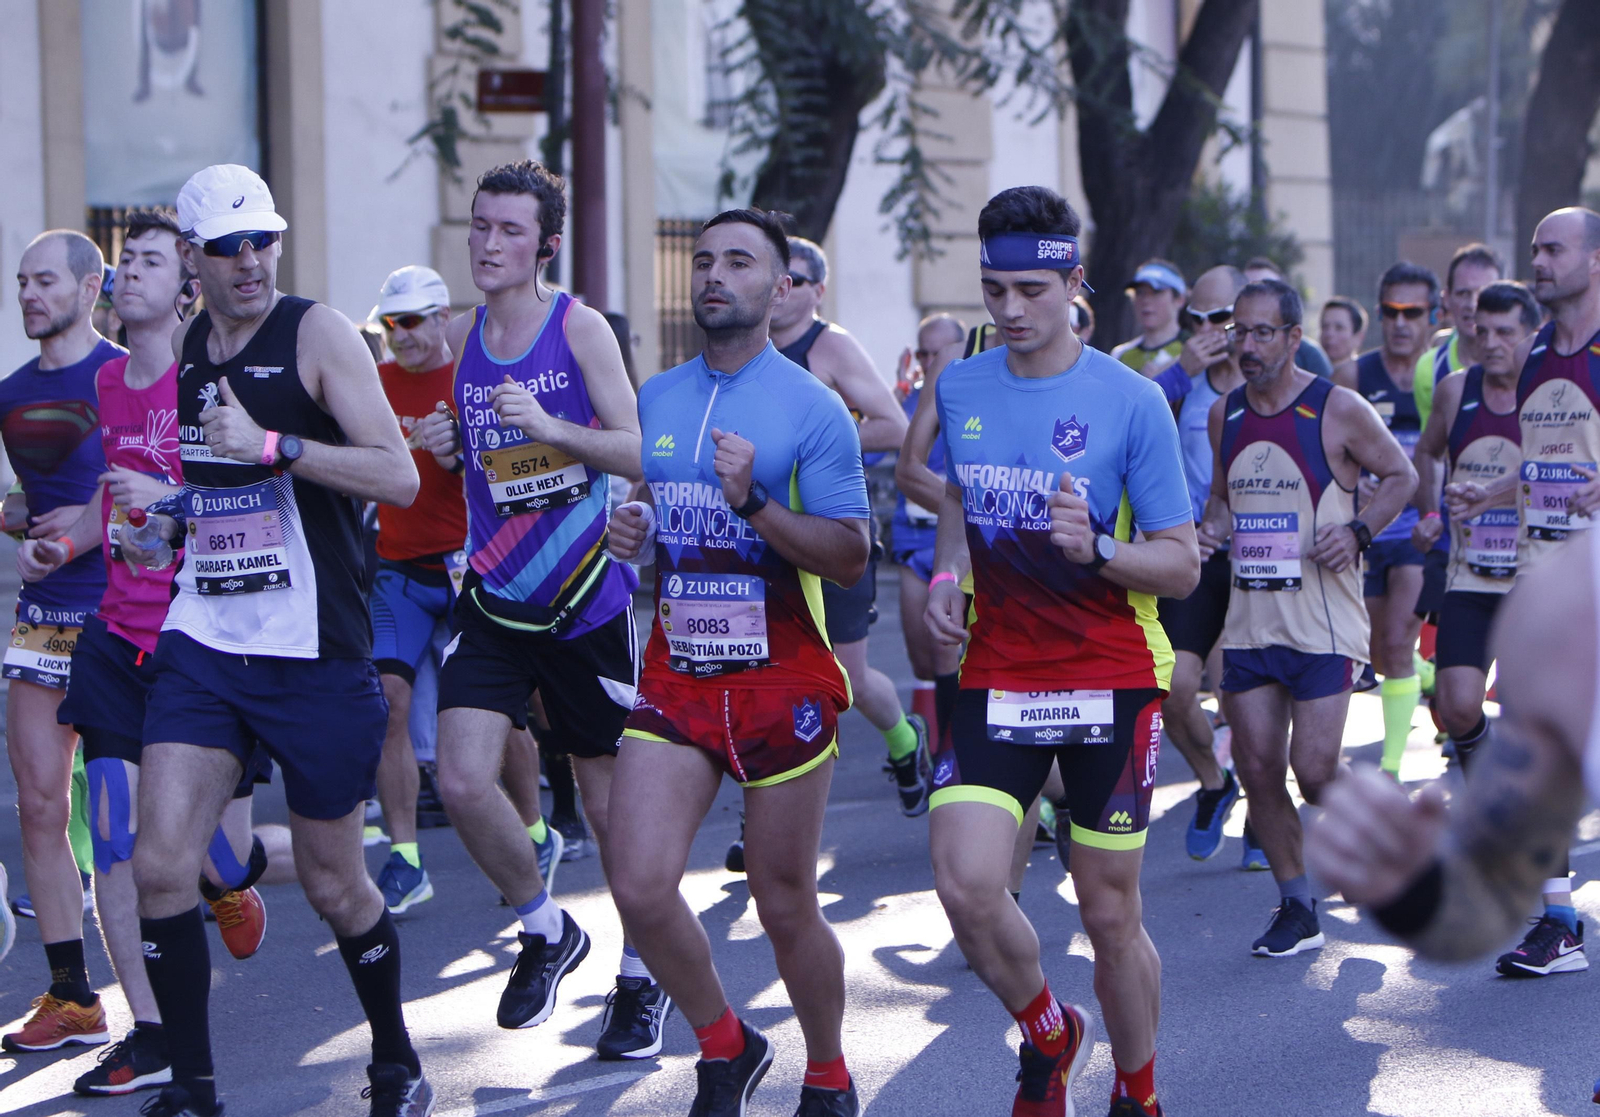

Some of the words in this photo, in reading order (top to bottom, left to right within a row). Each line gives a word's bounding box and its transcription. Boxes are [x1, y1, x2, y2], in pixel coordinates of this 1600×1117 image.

[1037, 249, 1067, 260] SPORT
[463, 370, 569, 405] Panatic
[464, 405, 501, 428] Can
[120, 435, 144, 445] trust
[1539, 443, 1573, 456] JORGE
[511, 455, 550, 476] 5574
[506, 482, 535, 497] OLLIE
[536, 474, 564, 490] HEXT
[955, 464, 1091, 500] INFORMALS
[205, 493, 261, 512] ZURICH
[567, 493, 587, 504] ZURICH
[997, 518, 1014, 528] DEL
[1239, 518, 1288, 529] ZURICH
[1483, 513, 1518, 525] ZURIC
[209, 532, 246, 551] 6817
[681, 536, 699, 546] DEL
[705, 539, 737, 549] ALCOR
[1241, 546, 1272, 558] 6697
[195, 560, 235, 573] CHARAFA
[237, 554, 282, 571] KAMEL
[1240, 565, 1277, 574] ANTONIO
[263, 581, 288, 591] ZURICH
[686, 581, 750, 596] ZURICH
[45, 611, 86, 623] ZURIC
[687, 618, 730, 634] 8083
[43, 638, 75, 653] 4909
[728, 643, 763, 656] POZO
[37, 657, 70, 671] LUCKY
[1020, 707, 1080, 722] PATARRA
